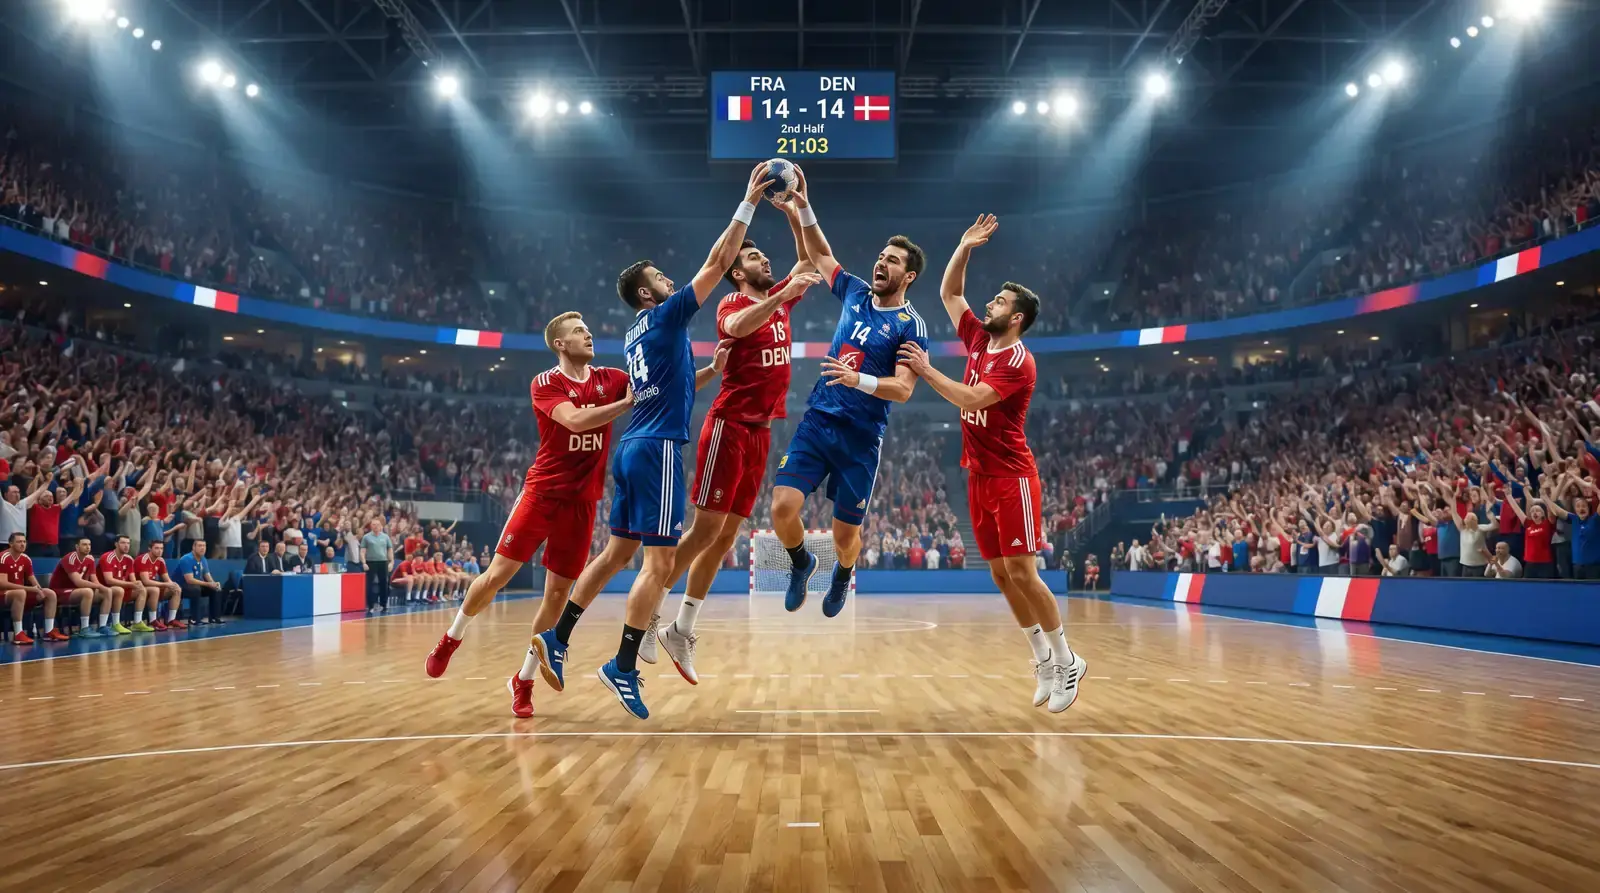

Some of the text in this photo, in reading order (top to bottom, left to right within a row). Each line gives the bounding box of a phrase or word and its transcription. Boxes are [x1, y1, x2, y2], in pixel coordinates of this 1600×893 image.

[751, 77, 855, 91] FRA DEN
[761, 98, 790, 118] 14
[817, 98, 845, 118] 14
[781, 124, 824, 133] 2nd Half
[776, 137, 829, 154] 21:03
[850, 321, 872, 346] 14
[761, 346, 790, 367] DEN
[568, 433, 603, 452] DEN
